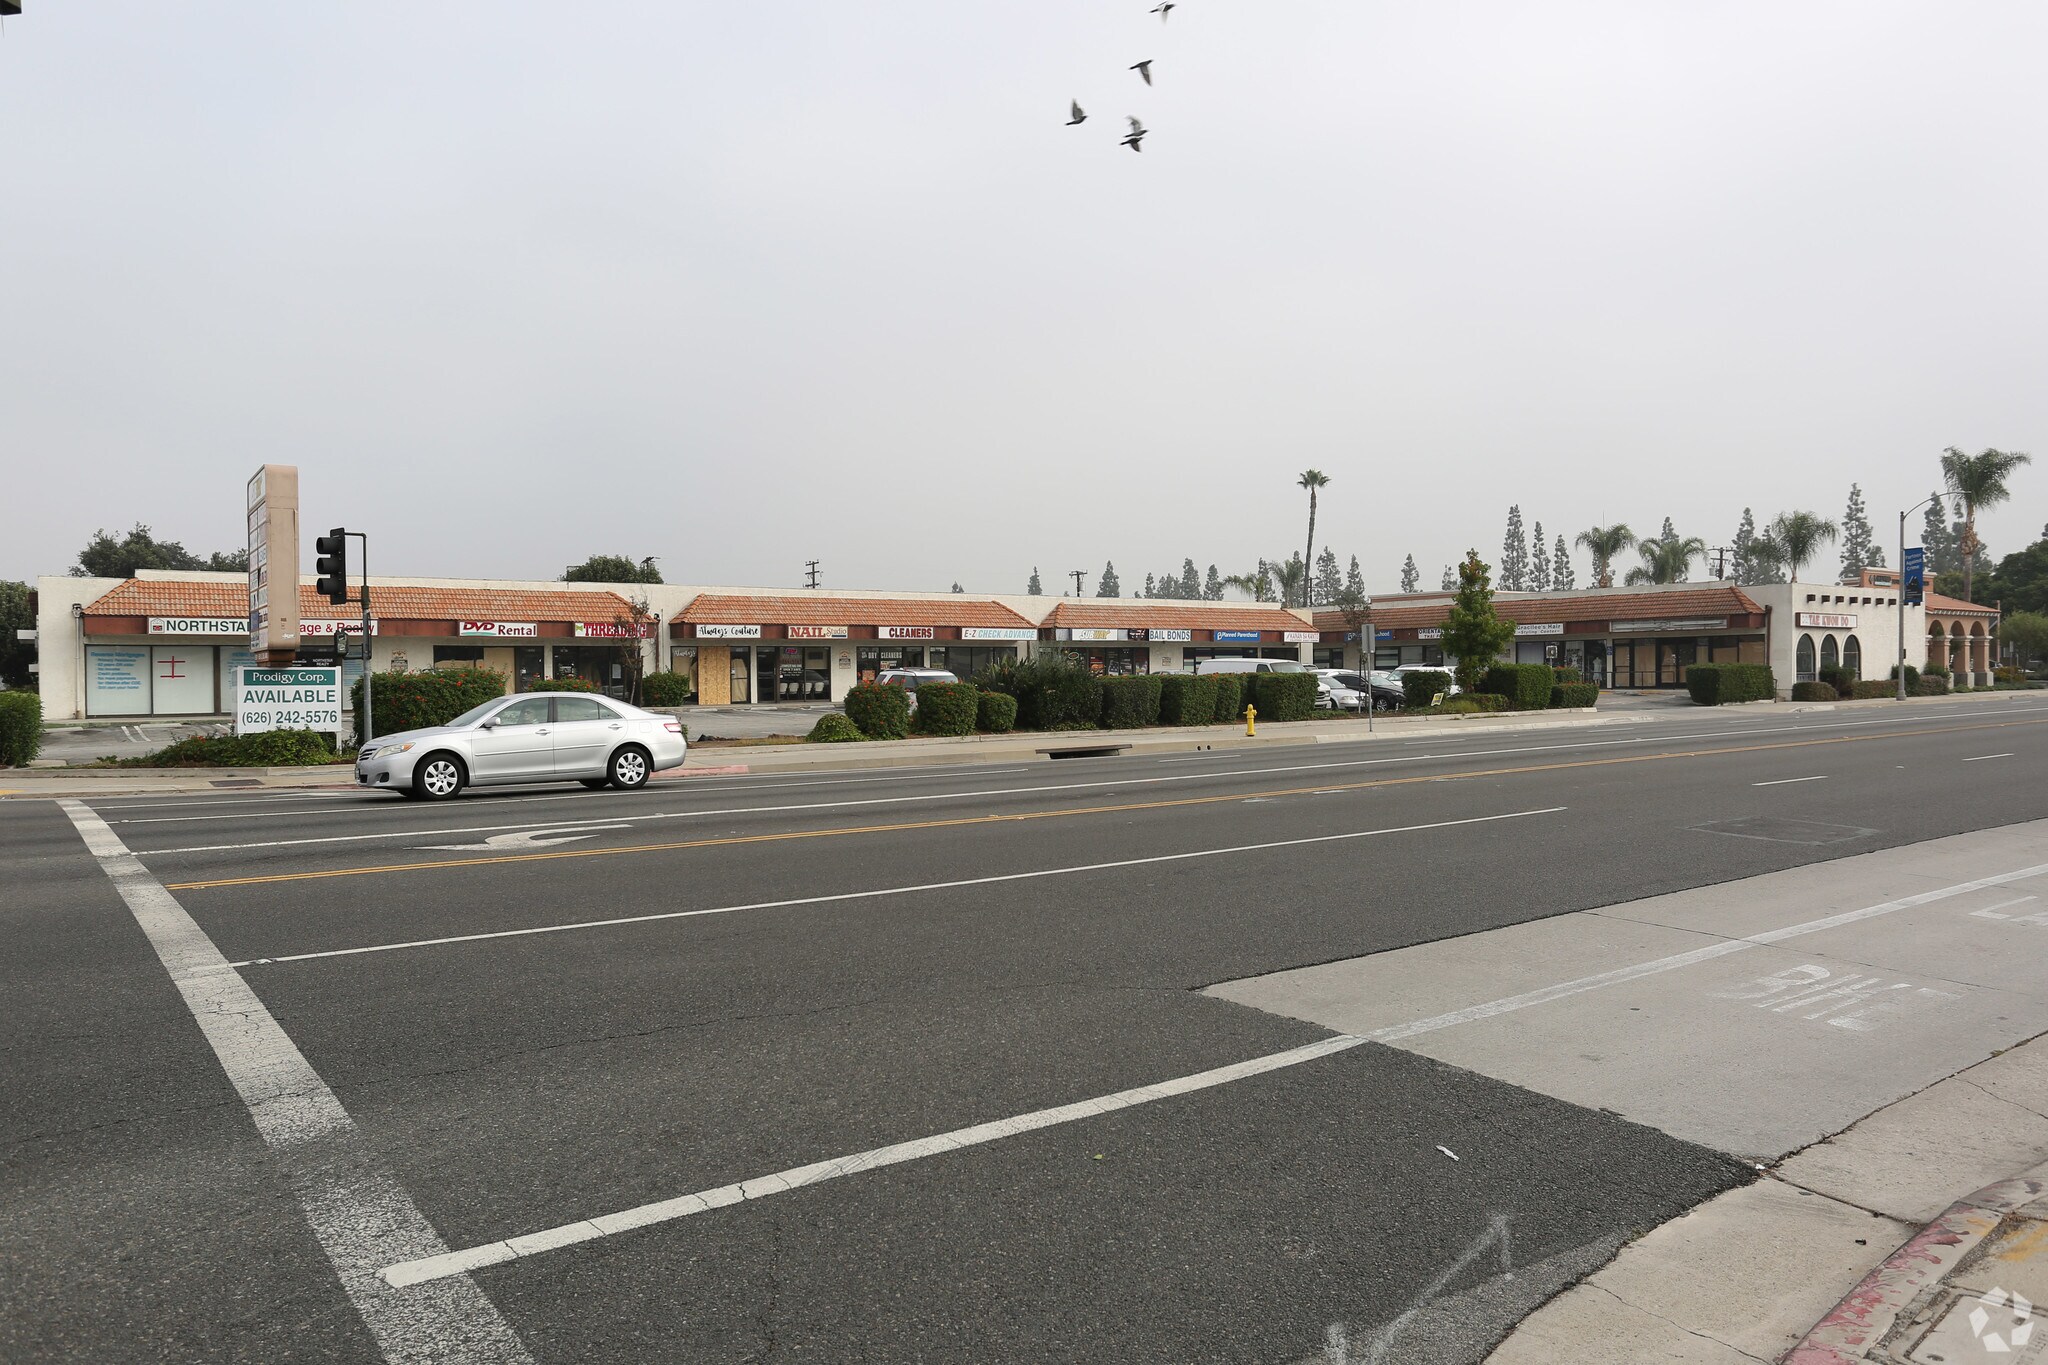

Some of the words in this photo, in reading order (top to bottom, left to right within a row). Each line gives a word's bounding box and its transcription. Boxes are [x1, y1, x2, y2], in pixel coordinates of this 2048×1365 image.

[166, 620, 250, 632] NORTHSTA
[1809, 615, 1820, 625] TAE
[1822, 616, 1839, 626] KWON
[1841, 616, 1849, 627] DO
[325, 623, 333, 633] &
[463, 622, 495, 631] DVD
[498, 624, 536, 636] Rental
[790, 626, 826, 637] NAIL
[826, 627, 847, 637] Studio
[889, 627, 932, 639] CLEANERS
[964, 630, 976, 638] E-Z
[977, 630, 1001, 639] CHECK
[1003, 630, 1036, 639] ADVANCE
[1079, 629, 1111, 640] SUBWAY
[1150, 630, 1166, 640] BAIL
[1167, 630, 1190, 640] BONDS
[881, 651, 902, 659] CLEANERS
[253, 672, 295, 683] Prodigy
[298, 672, 327, 683] Corp.
[243, 690, 336, 703] AVAILABLE
[242, 711, 272, 726] (626)
[275, 710, 338, 724] 242-5576
